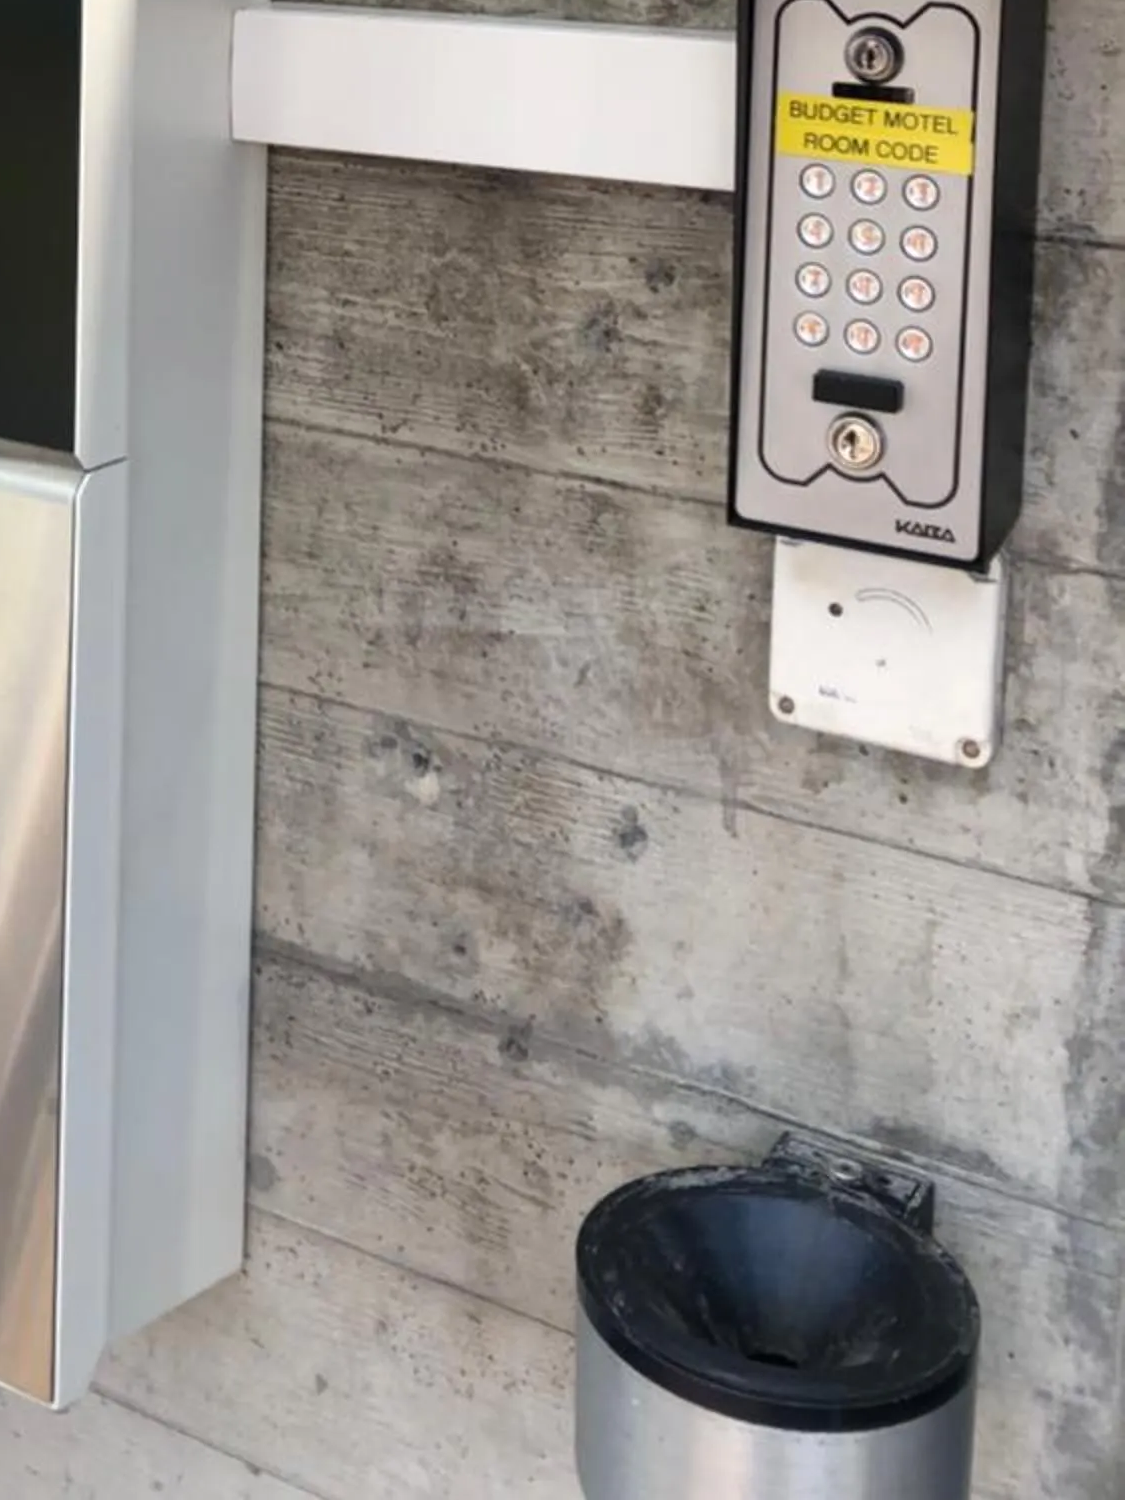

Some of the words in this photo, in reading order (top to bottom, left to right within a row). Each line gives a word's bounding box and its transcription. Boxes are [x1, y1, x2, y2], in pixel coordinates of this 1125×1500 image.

[789, 100, 877, 125] BUDGET
[883, 110, 958, 135] MOTEL
[803, 132, 869, 156] ROOM
[876, 140, 939, 164] CODE
